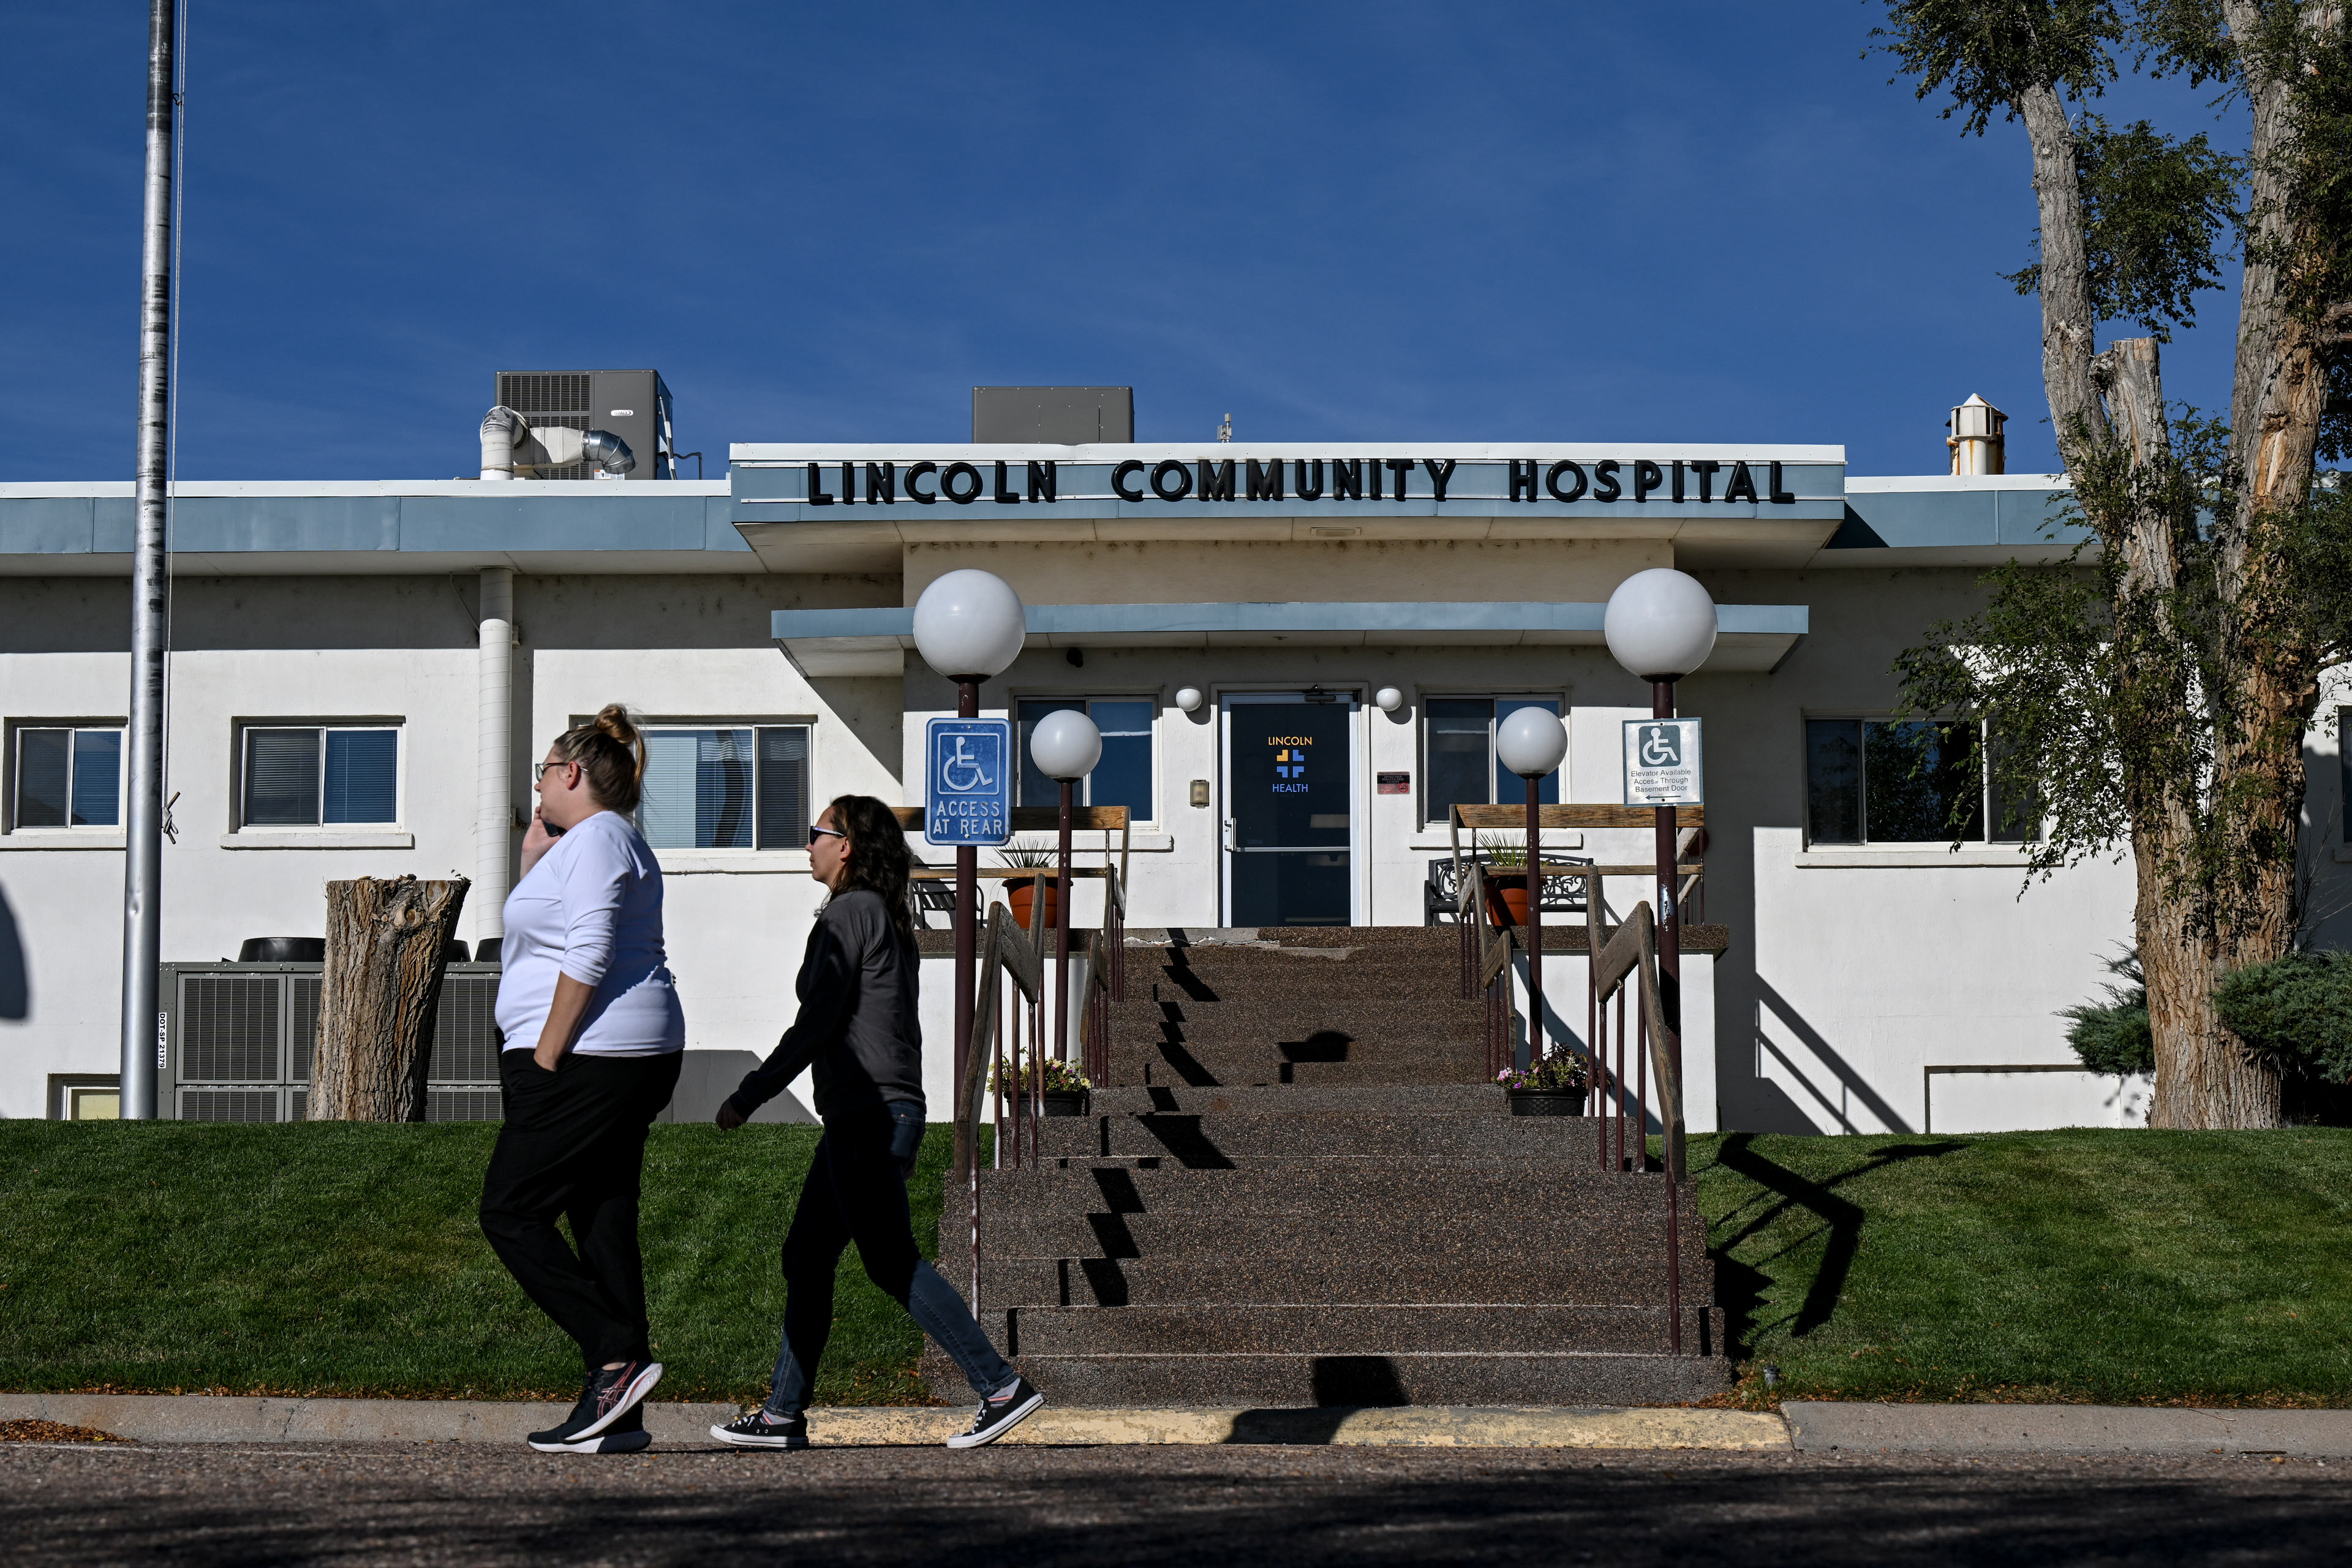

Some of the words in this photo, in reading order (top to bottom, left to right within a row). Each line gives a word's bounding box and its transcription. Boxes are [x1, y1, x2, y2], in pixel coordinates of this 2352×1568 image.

[808, 459, 1057, 506] LINCOLN
[1111, 458, 1457, 502] COMMUNITY
[1509, 459, 1796, 505] HOSPITAL
[1268, 736, 1312, 745] LINCOLN
[1272, 783, 1308, 793] HEALTH
[937, 801, 1000, 816] ACCESS
[933, 819, 950, 834] AT
[960, 820, 1003, 835] REAR
